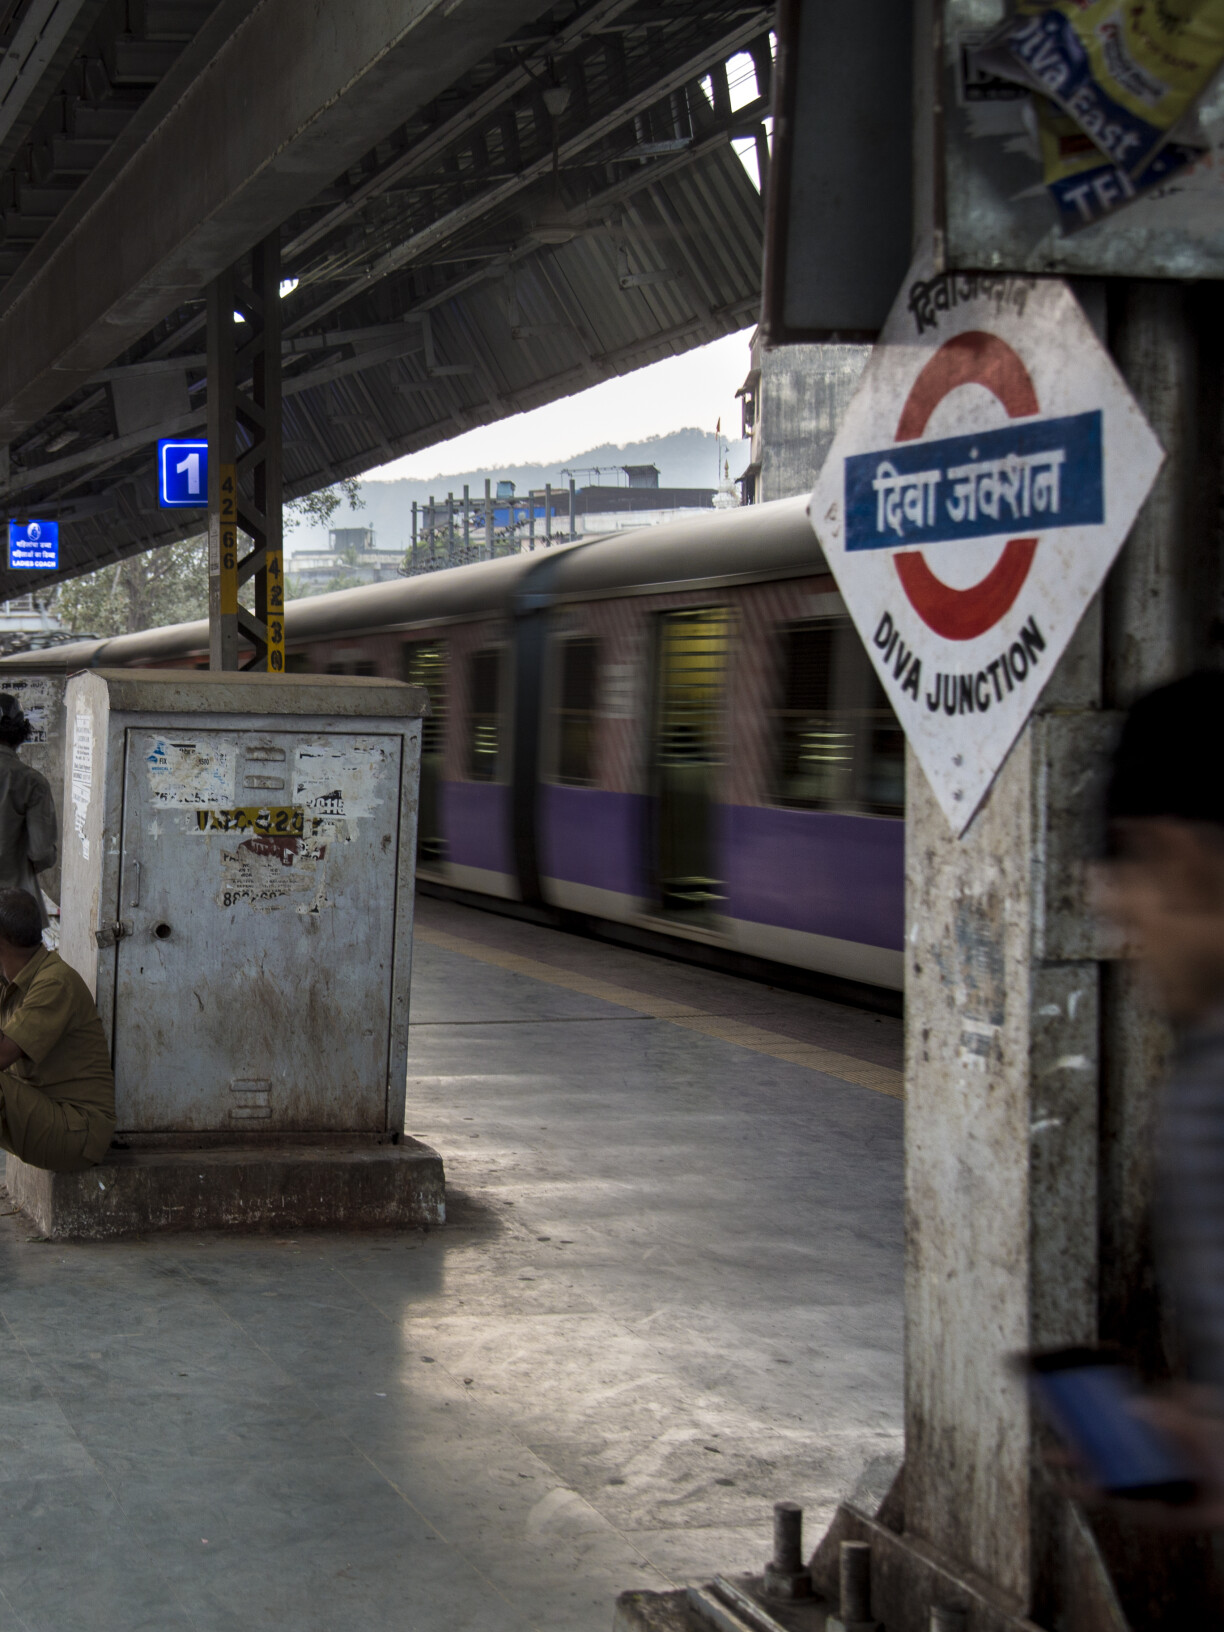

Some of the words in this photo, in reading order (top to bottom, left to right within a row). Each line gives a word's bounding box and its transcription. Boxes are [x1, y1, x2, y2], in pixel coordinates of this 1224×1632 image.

[1069, 83, 1141, 160] East
[176, 453, 200, 494] 1
[221, 476, 234, 515] 42
[872, 461, 942, 537] दिवा
[945, 447, 1067, 522] जंक्शन
[222, 531, 235, 570] 66
[873, 611, 921, 702] DIVA
[926, 615, 1047, 716] JUNCTION
